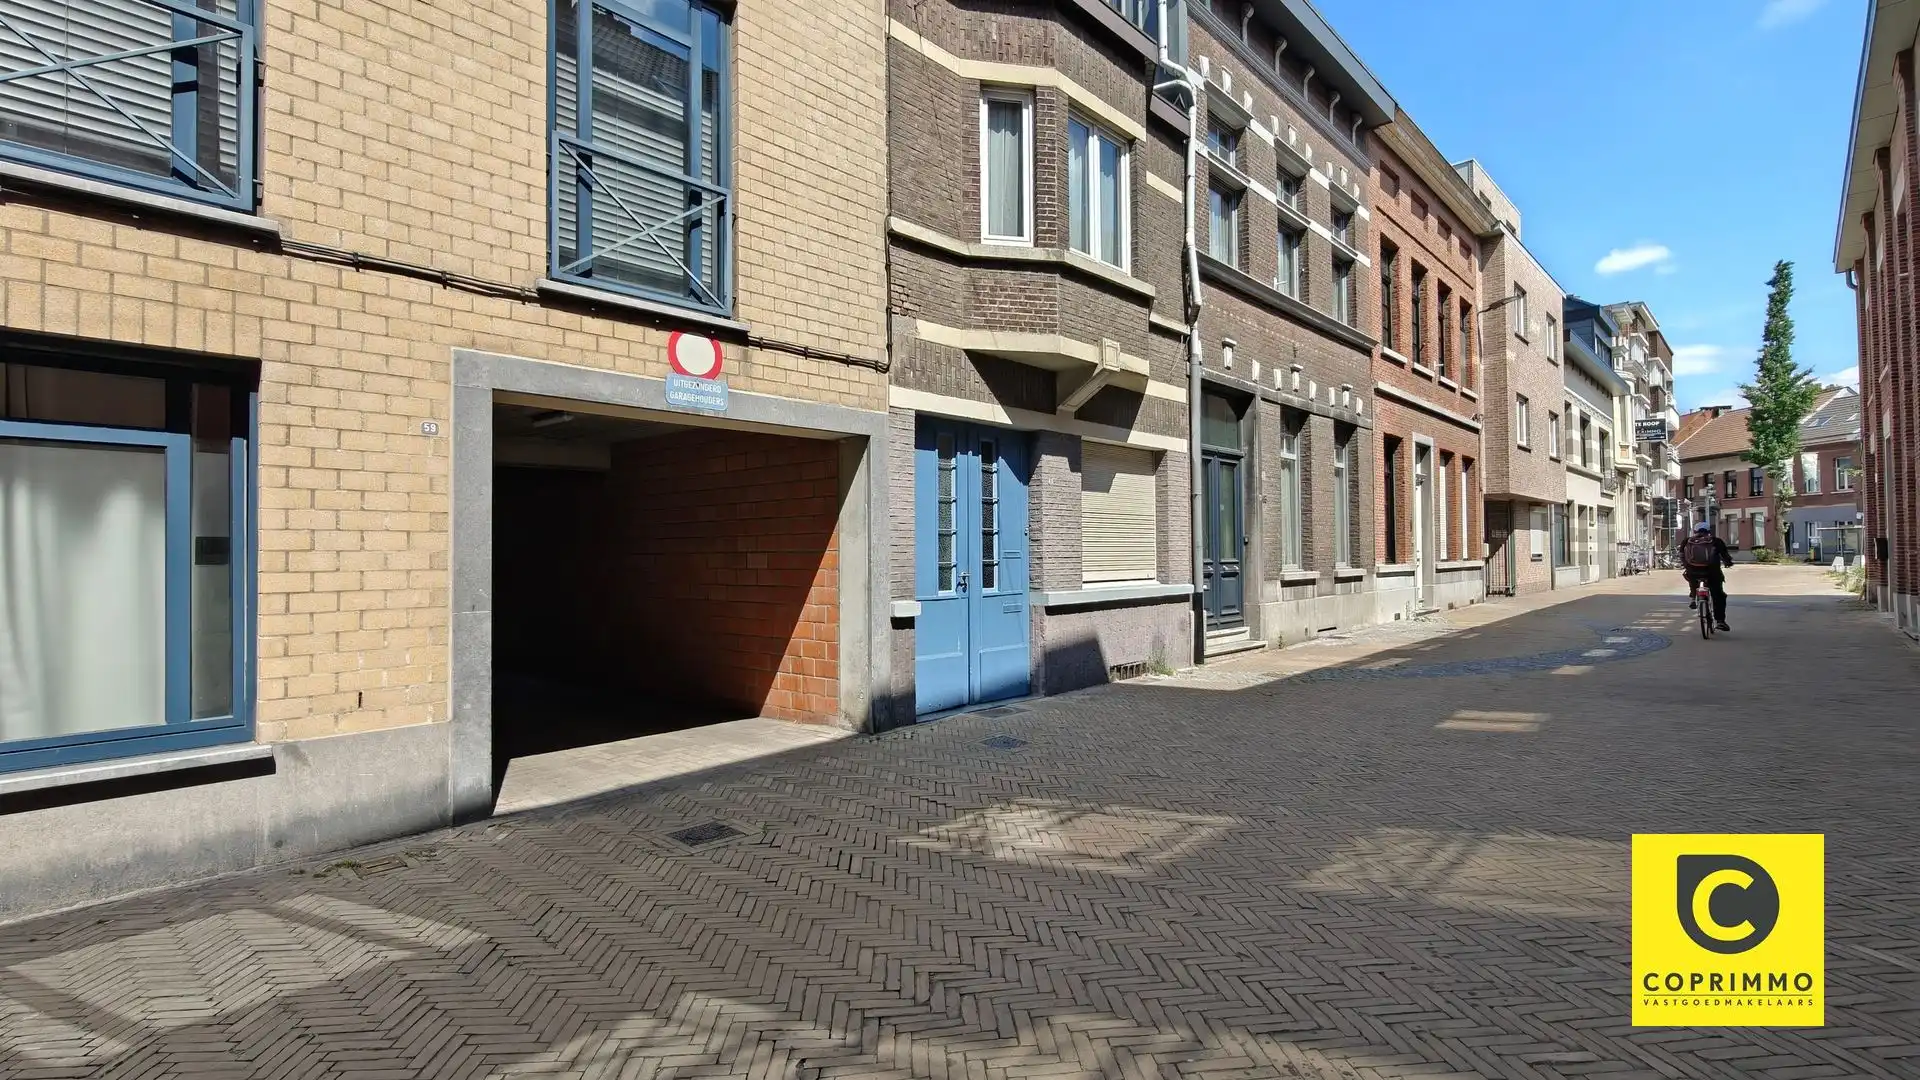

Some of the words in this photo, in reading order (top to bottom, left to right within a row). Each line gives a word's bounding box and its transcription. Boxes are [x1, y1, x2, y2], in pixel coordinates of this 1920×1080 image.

[673, 378, 722, 394] UITGEZONDERD
[669, 390, 725, 406] GARAGEHOUDERS
[424, 423, 436, 432] 59
